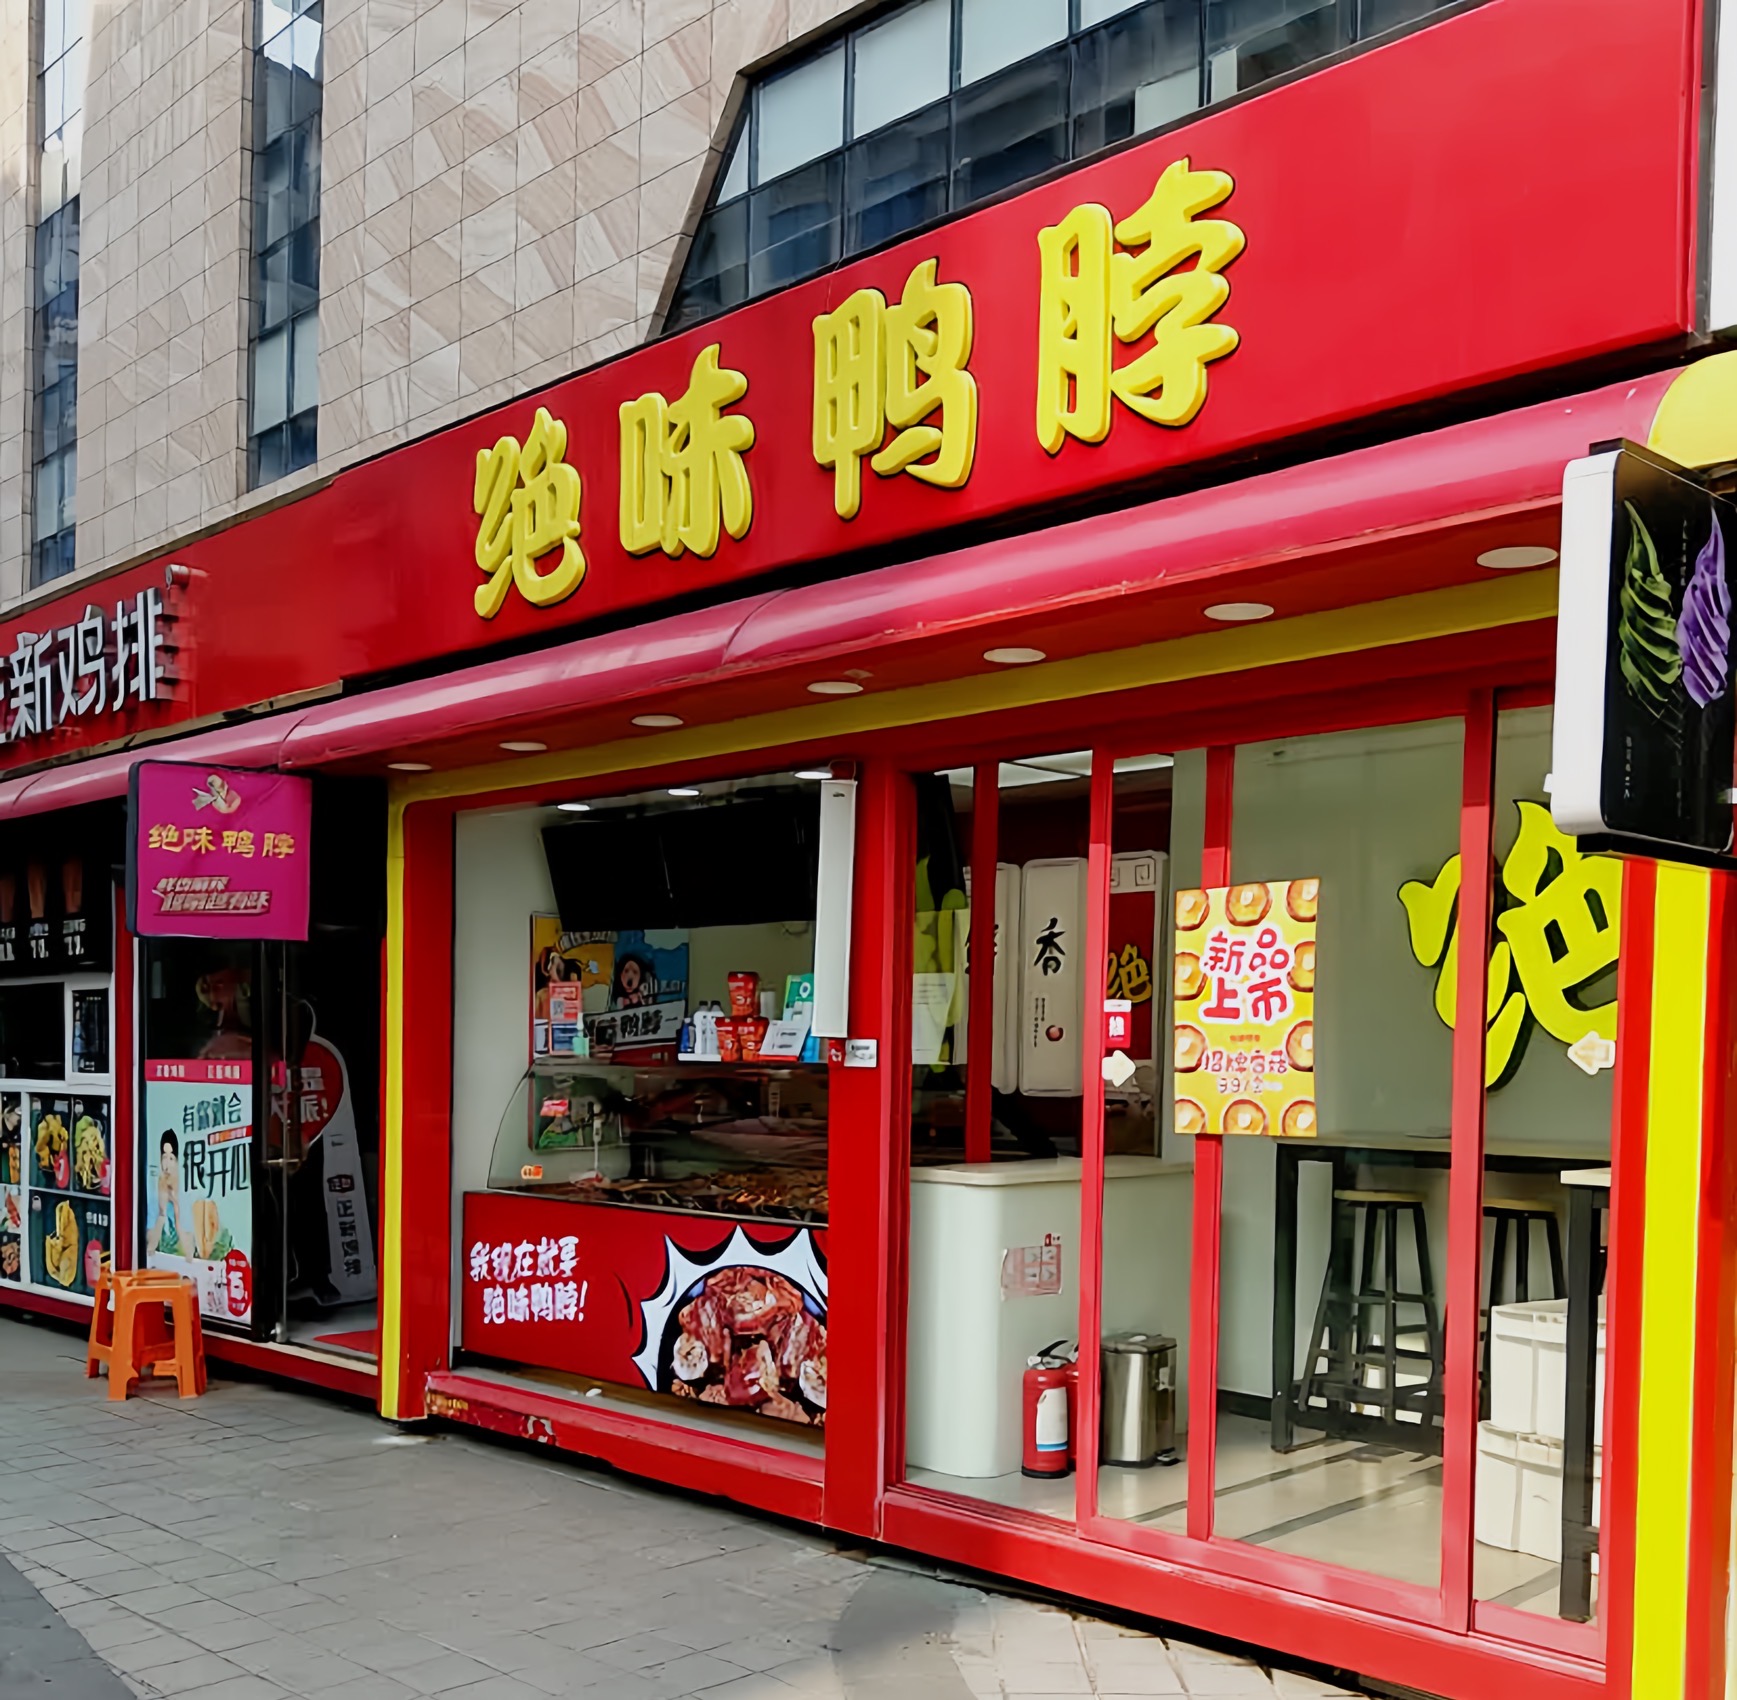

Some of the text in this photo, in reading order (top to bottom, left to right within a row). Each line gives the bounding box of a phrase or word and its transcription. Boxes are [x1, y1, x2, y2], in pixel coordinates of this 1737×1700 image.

[473, 156, 1247, 620] 绝味鸭脖
[0, 587, 164, 743] 新鸡排
[148, 824, 295, 859] 绝味鸭脖
[1033, 917, 1066, 976] 香
[1204, 927, 1290, 976] 新品
[1202, 971, 1288, 1022] 上市
[182, 1139, 250, 1199] 很开心
